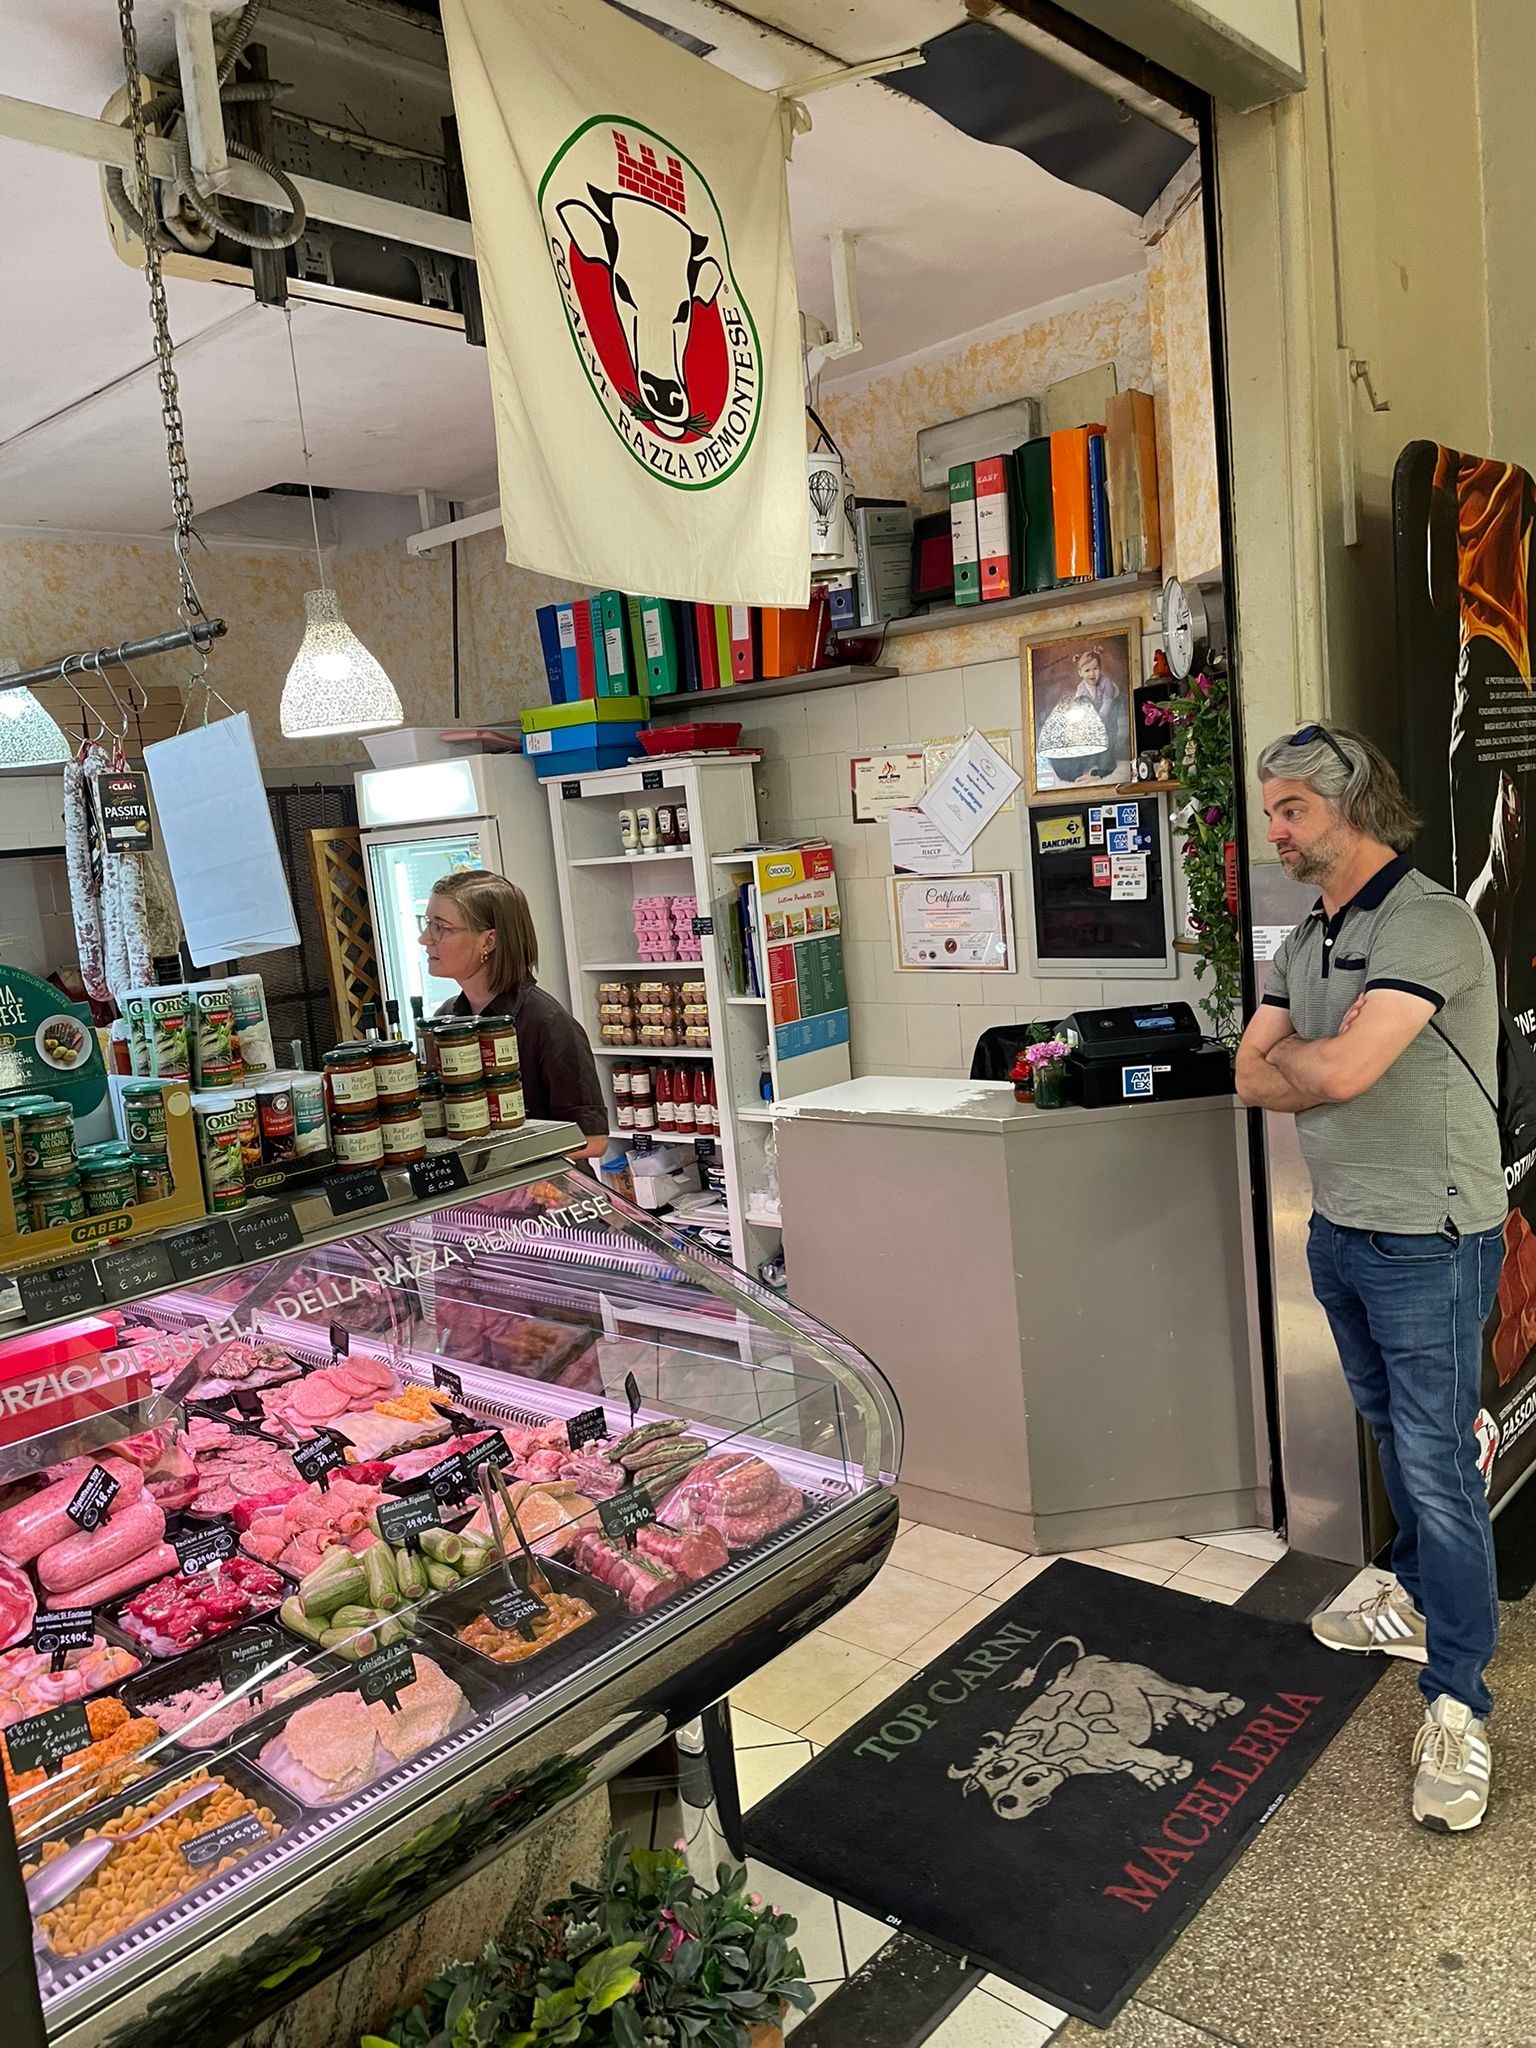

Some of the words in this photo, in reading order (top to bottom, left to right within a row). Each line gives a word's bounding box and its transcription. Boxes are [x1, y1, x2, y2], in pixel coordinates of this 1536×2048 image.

[617, 411, 692, 480] RAZZA
[694, 306, 754, 479] PIEMONTESE
[104, 804, 148, 819] PASSITA
[1041, 835, 1082, 850] BANCOMAT
[926, 887, 971, 908] Certificato
[1131, 1072, 1150, 1082] AM
[1134, 1081, 1151, 1091] EX
[255, 1174, 282, 1187] CABER
[76, 1218, 128, 1240] CABER
[100, 1351, 144, 1383] DI
[151, 1306, 272, 1364] TUTELA
[274, 1270, 373, 1324] DELLA
[376, 1242, 465, 1290] RAZZA
[463, 1195, 611, 1262] PIEMONTESE
[853, 1702, 938, 1763] TOP
[928, 1621, 1042, 1705] CARNI
[1102, 1689, 1326, 1914] MACELLERIA
[181, 1832, 216, 1851] Tortellini
